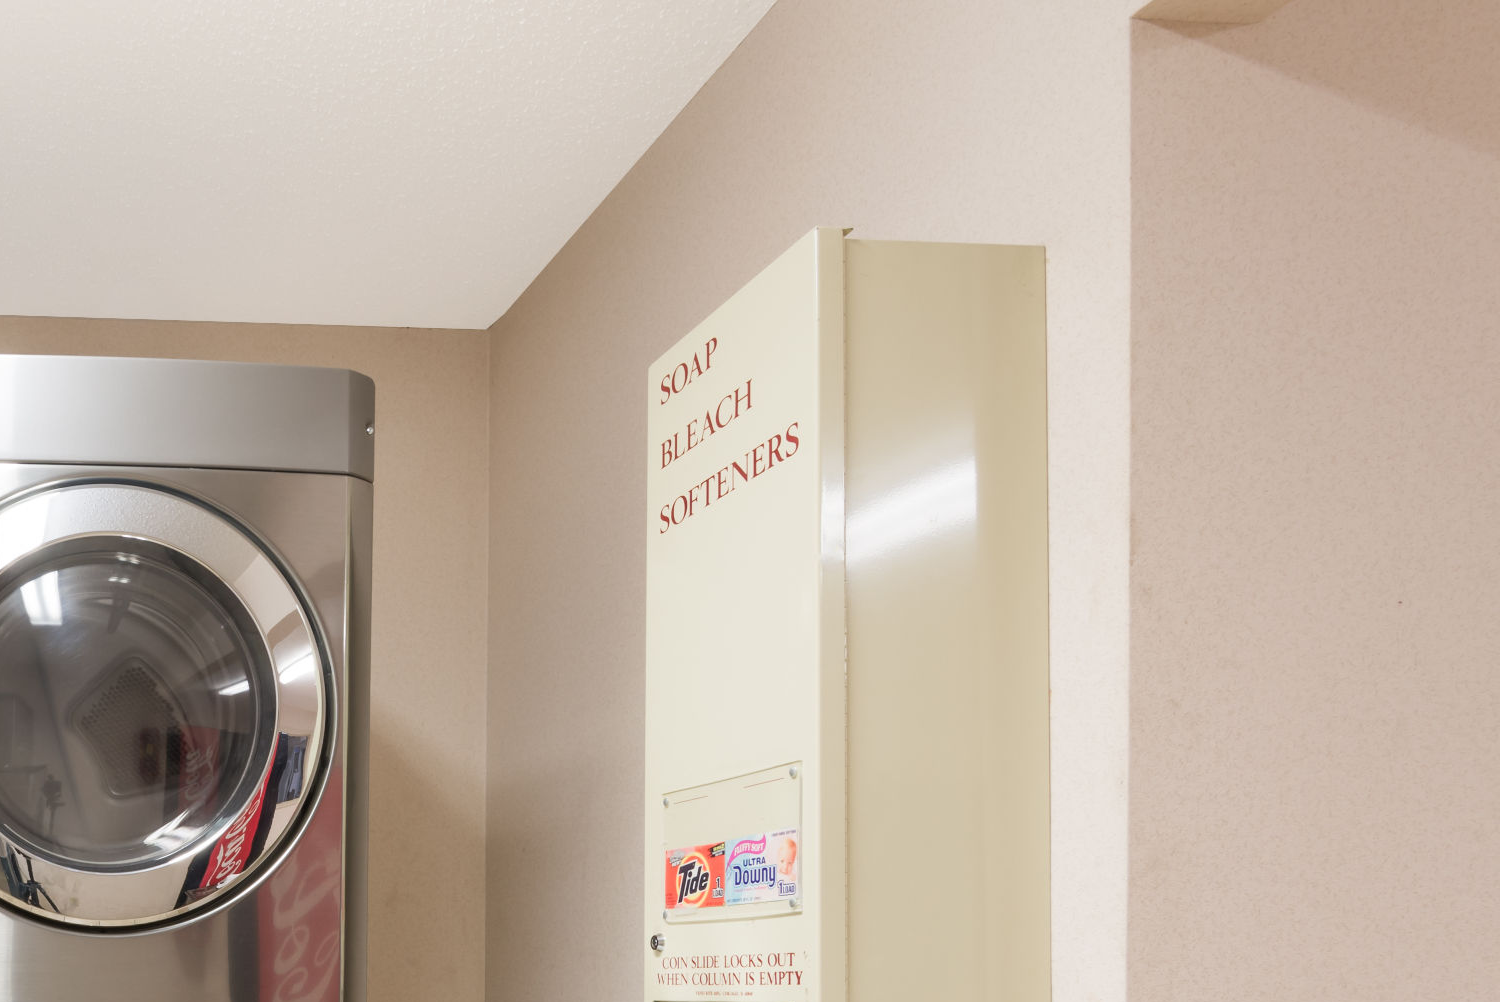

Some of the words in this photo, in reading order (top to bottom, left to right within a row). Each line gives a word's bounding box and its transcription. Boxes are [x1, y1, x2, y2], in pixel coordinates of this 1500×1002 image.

[660, 337, 718, 406] SOAP
[660, 378, 753, 470] BLEACH
[659, 422, 800, 535] SOFTENERS
[742, 856, 766, 867] ULTRA
[677, 860, 710, 904] Tide
[715, 877, 721, 888] 1
[732, 865, 776, 887] Downy
[662, 957, 688, 969] COIN
[691, 955, 719, 969] SLIDE
[724, 953, 763, 968] LOCKS
[767, 952, 795, 967] OUT
[657, 972, 688, 985] WHEN
[691, 972, 741, 986] COLUMN
[745, 972, 755, 985] IS
[759, 971, 803, 985] EMPTY
